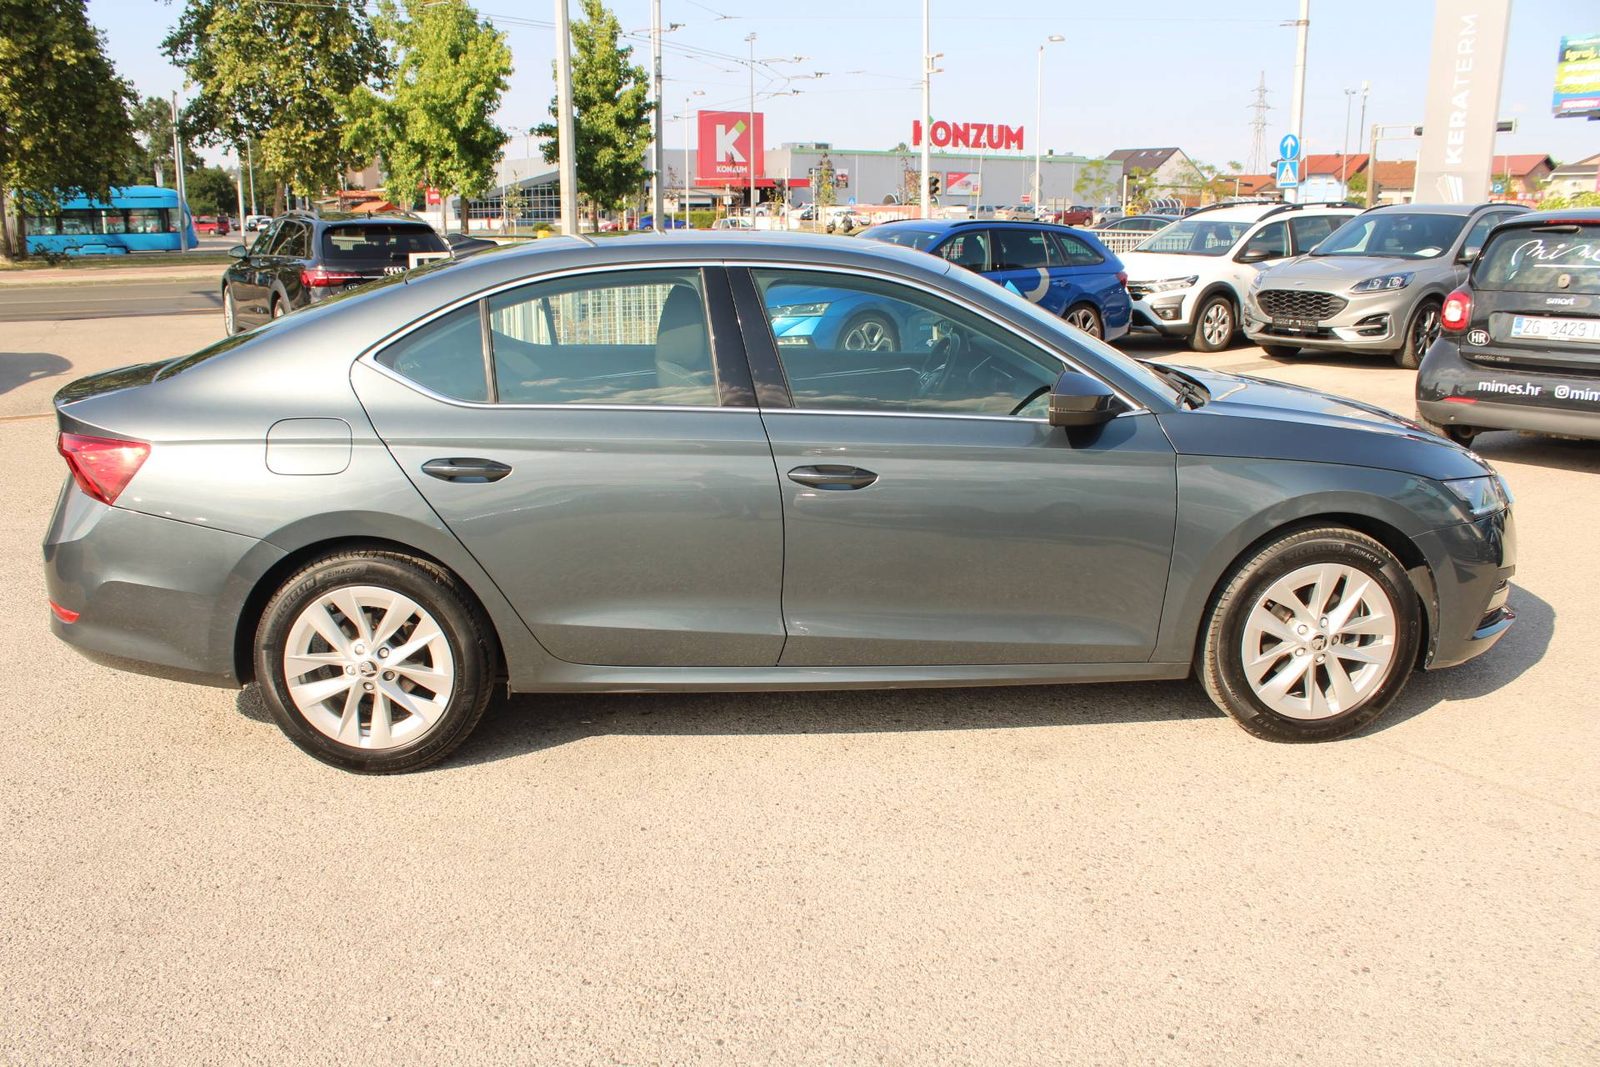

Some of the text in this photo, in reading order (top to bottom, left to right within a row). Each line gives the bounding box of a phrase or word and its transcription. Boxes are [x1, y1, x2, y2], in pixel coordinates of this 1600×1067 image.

[1445, 13, 1479, 165] KERATERM
[1545, 297, 1576, 305] smart
[1523, 319, 1542, 335] ZG
[1551, 321, 1587, 337] 3429
[1471, 332, 1487, 344] HR
[1478, 380, 1542, 396] mimes.hr
